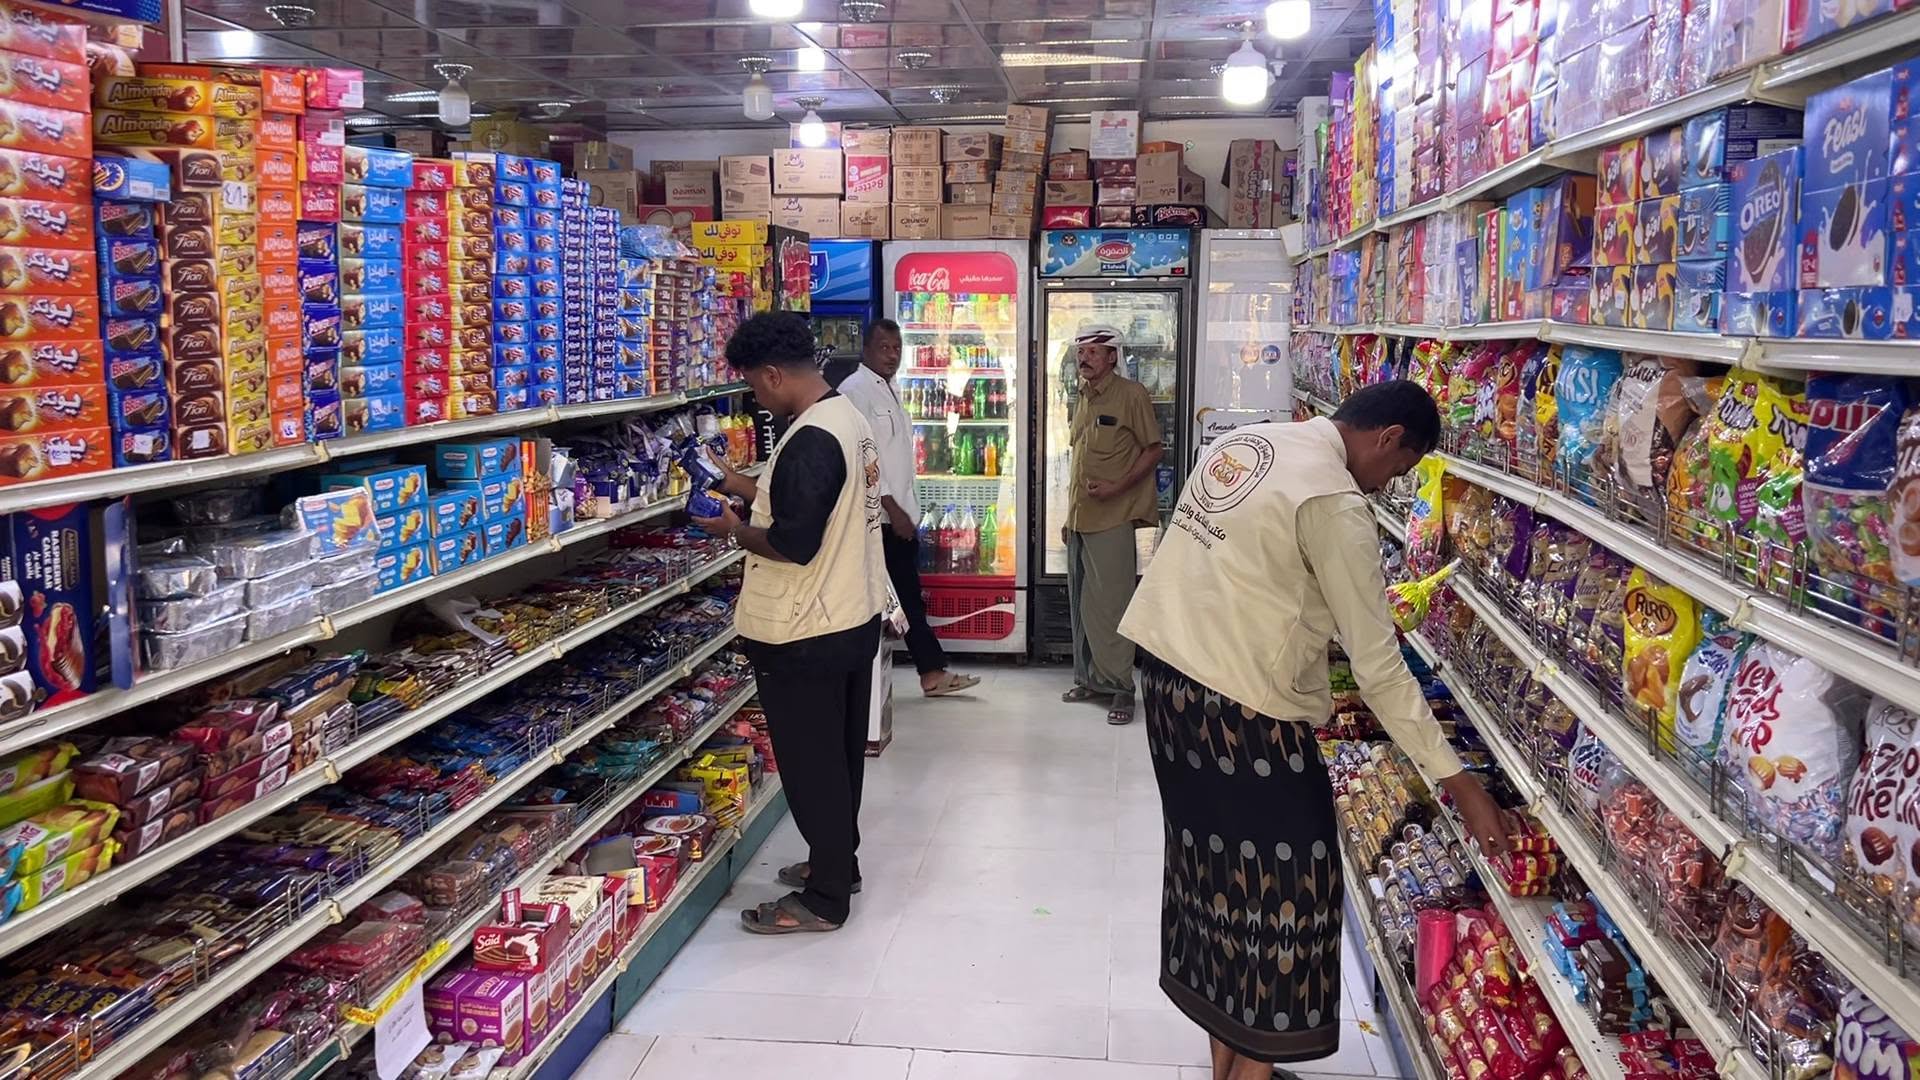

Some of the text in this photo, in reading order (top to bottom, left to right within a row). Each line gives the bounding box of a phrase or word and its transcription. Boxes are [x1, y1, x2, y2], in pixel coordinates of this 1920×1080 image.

[101, 114, 174, 136] Almonday
[1740, 190, 1781, 232] OREO
[42, 536, 53, 590] CAKE BAR
[51, 530, 62, 592] RASPBERRY
